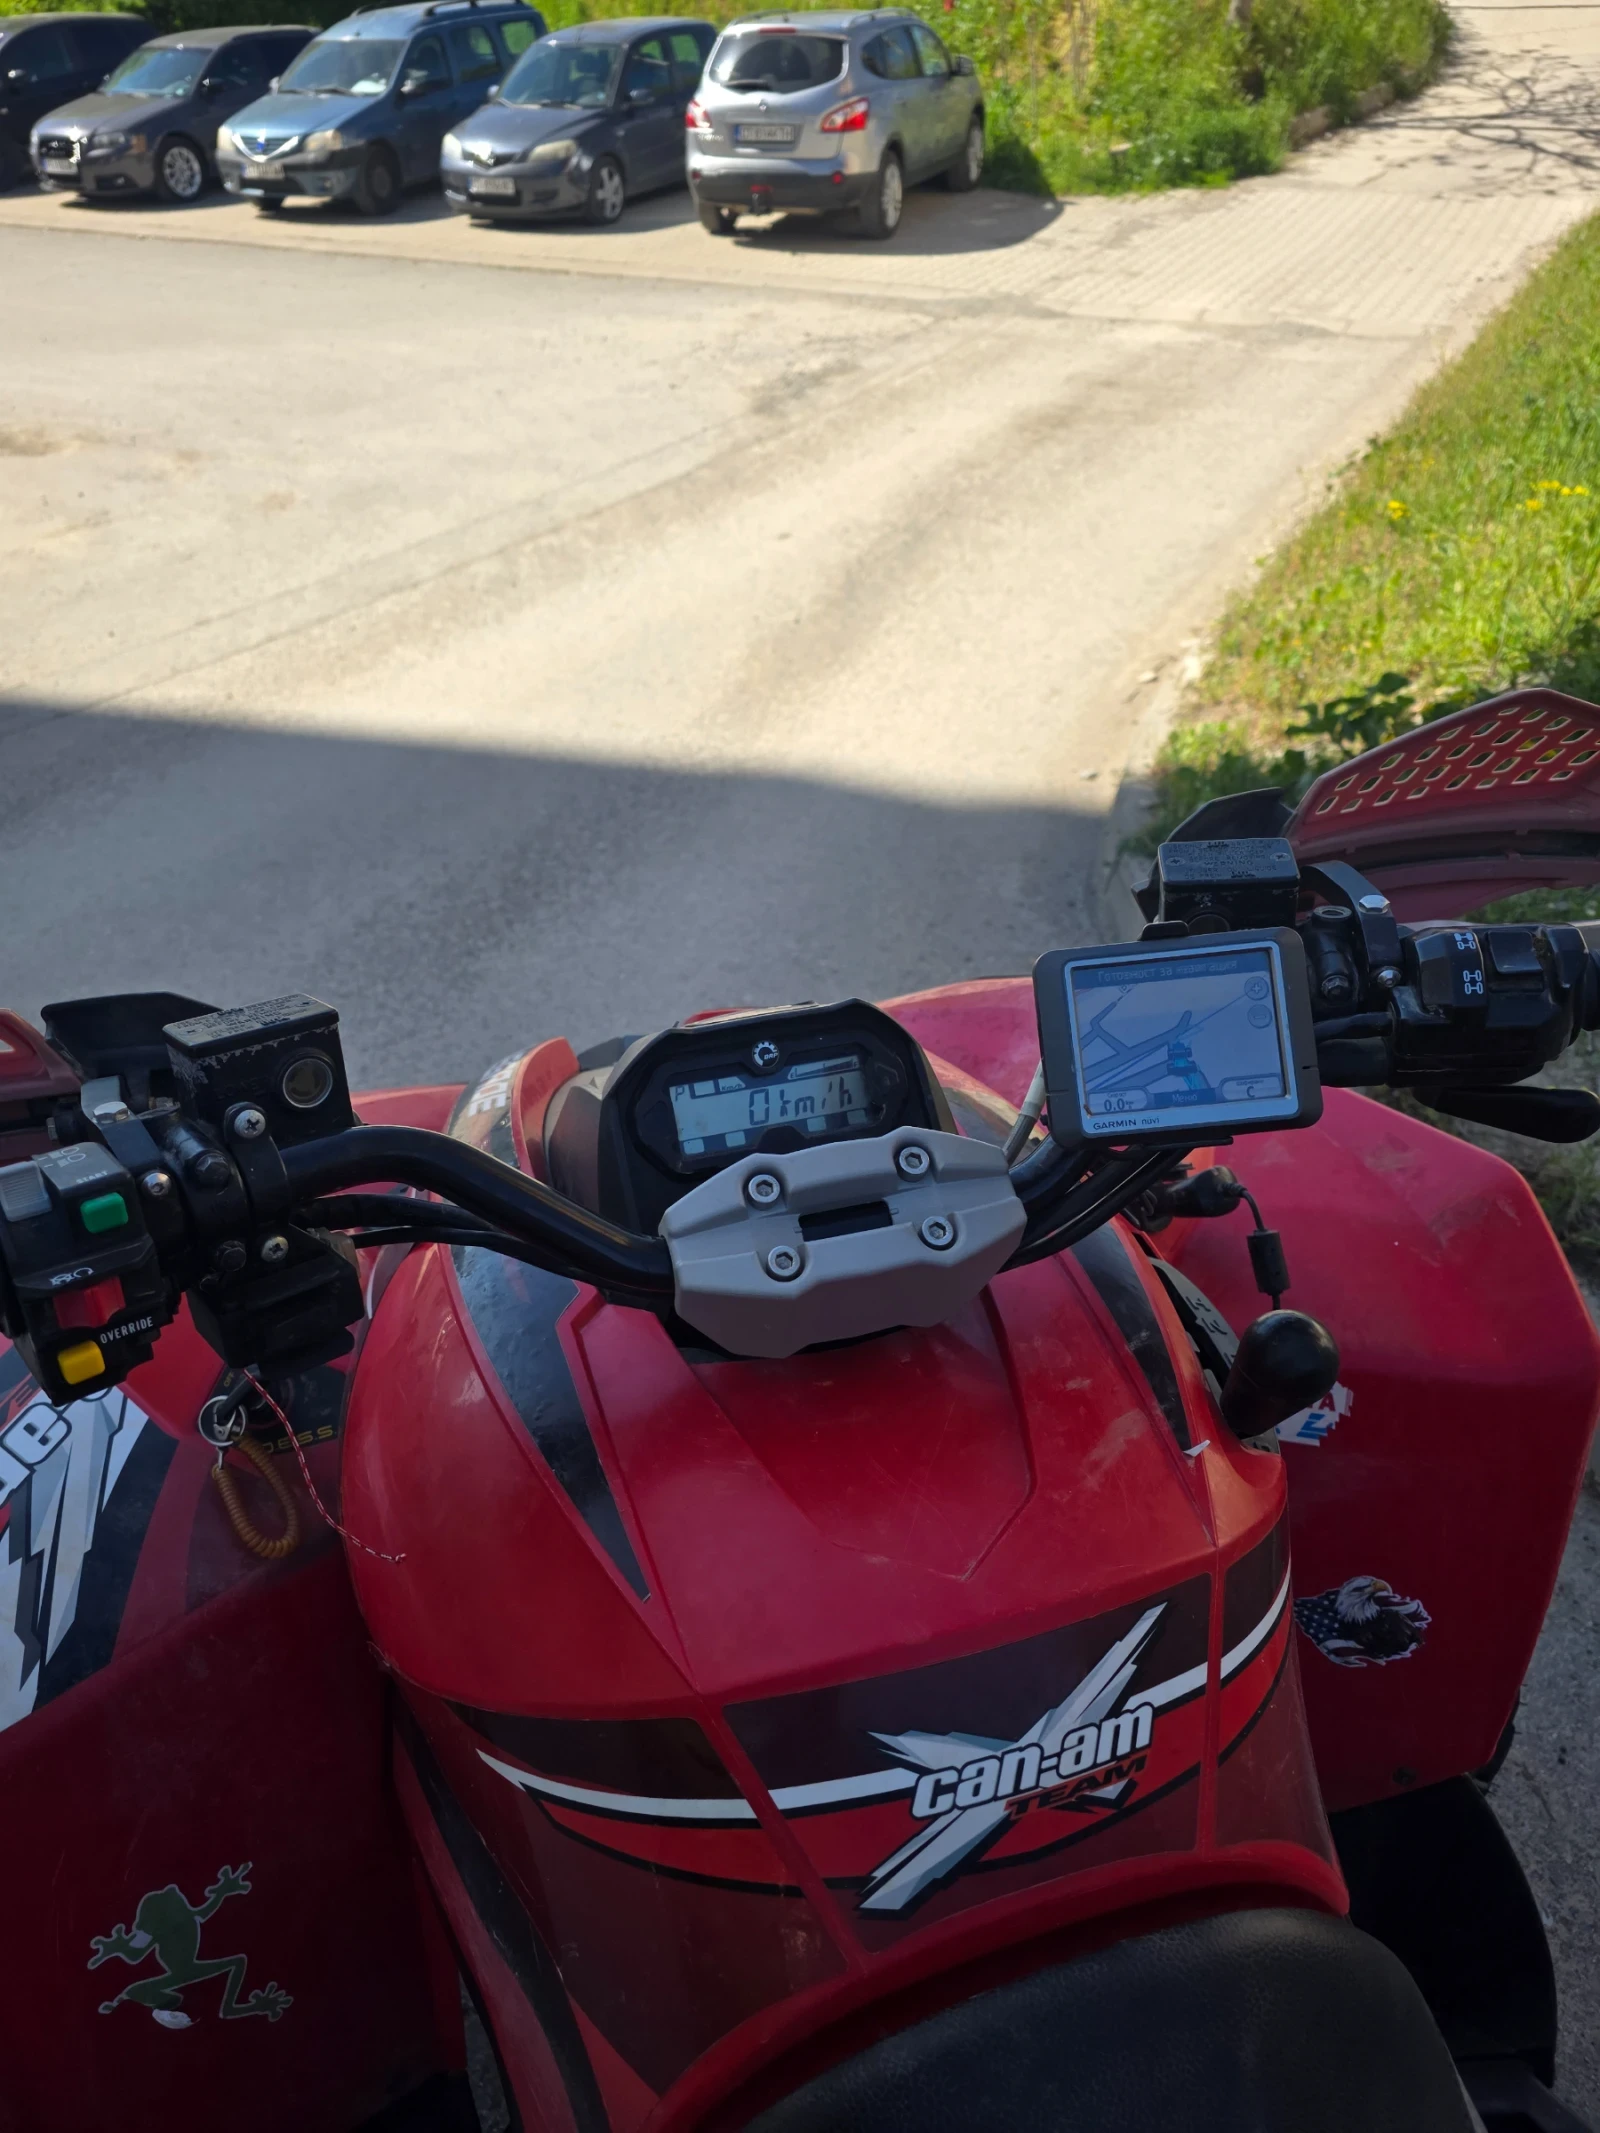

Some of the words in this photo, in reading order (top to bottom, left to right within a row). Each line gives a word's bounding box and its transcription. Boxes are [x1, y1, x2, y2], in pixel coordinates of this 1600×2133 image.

[1103, 1098, 1125, 1112] 0.0
[1092, 1118, 1137, 1131] GARMIN
[75, 1170, 108, 1184] START
[100, 1316, 154, 1344] OVERRIDE
[910, 1703, 1154, 1819] can-am
[1003, 1753, 1150, 1820] TEAM
